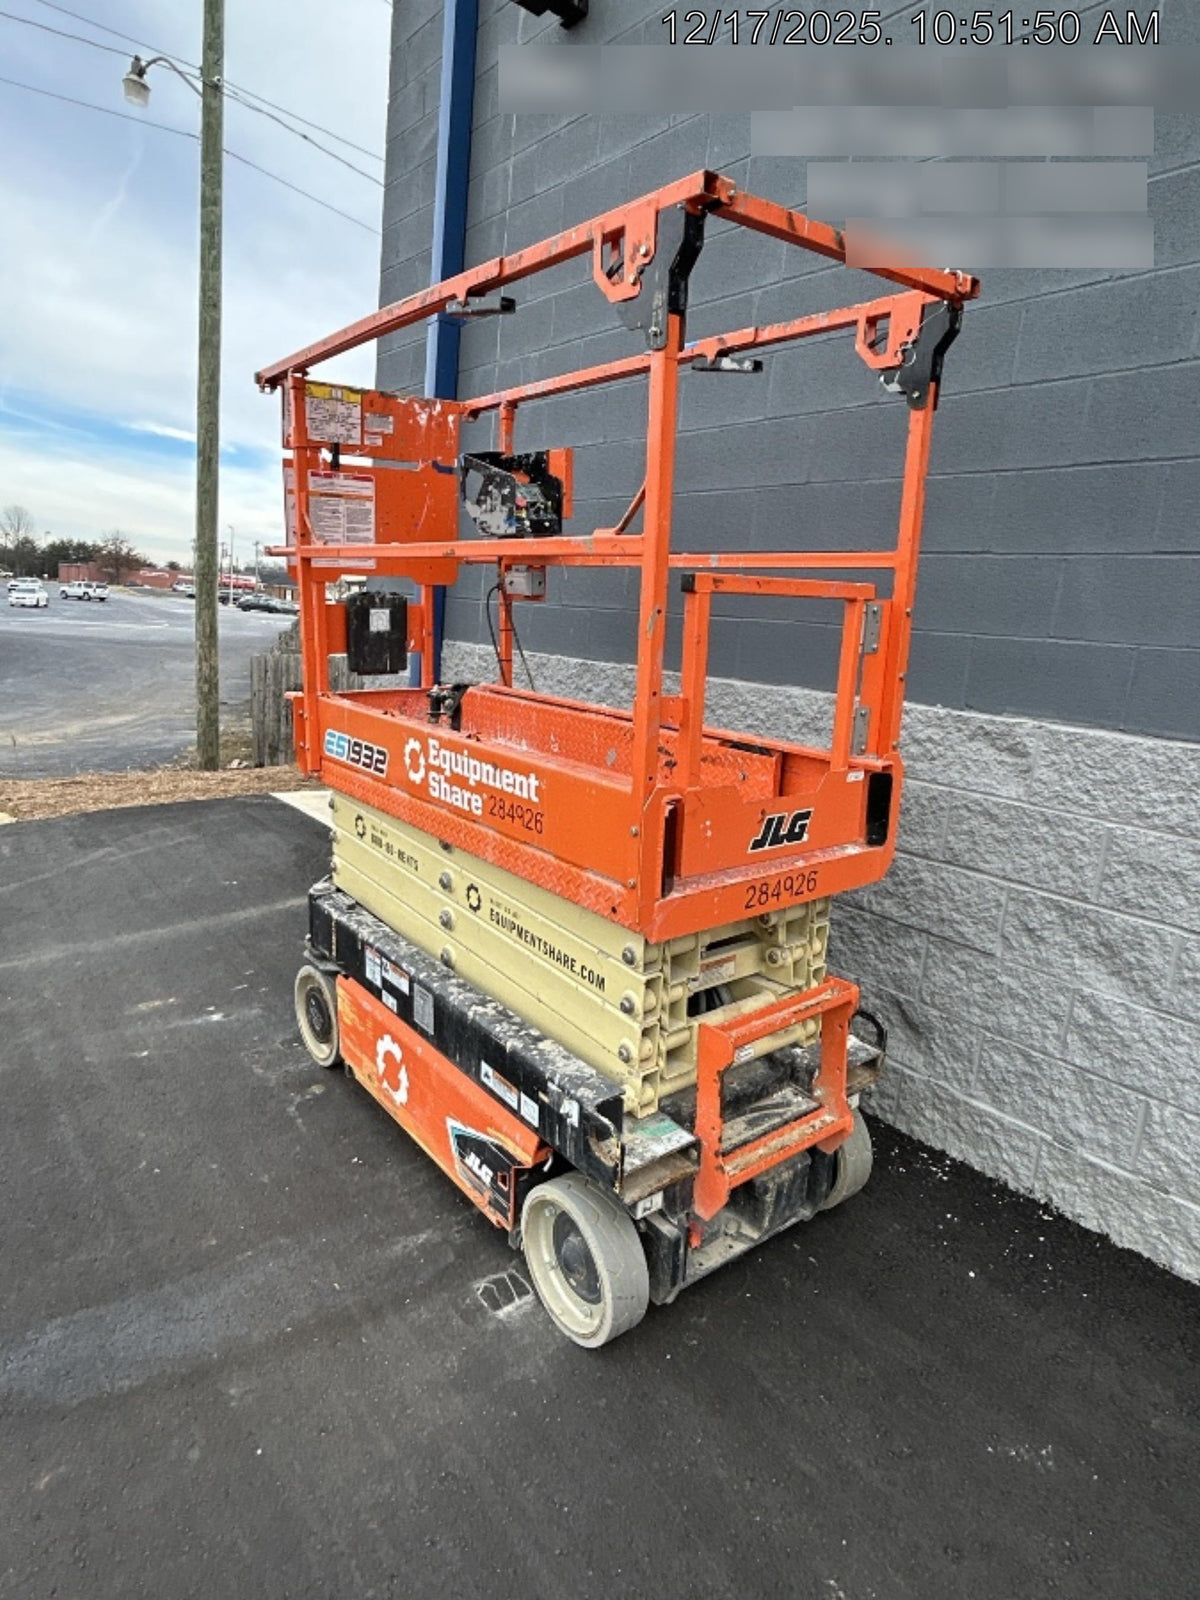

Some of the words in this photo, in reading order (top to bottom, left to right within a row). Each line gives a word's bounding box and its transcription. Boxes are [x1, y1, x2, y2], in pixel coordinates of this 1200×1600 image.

[324, 731, 387, 775] ES1932
[428, 738, 540, 803] Equipment
[428, 771, 483, 816] Share
[489, 795, 545, 835] 284926
[749, 809, 813, 852] JLG
[744, 870, 819, 910] 284926
[489, 907, 607, 993] EQUIPMENTSHARE.COM
[464, 1151, 494, 1189] JLG
